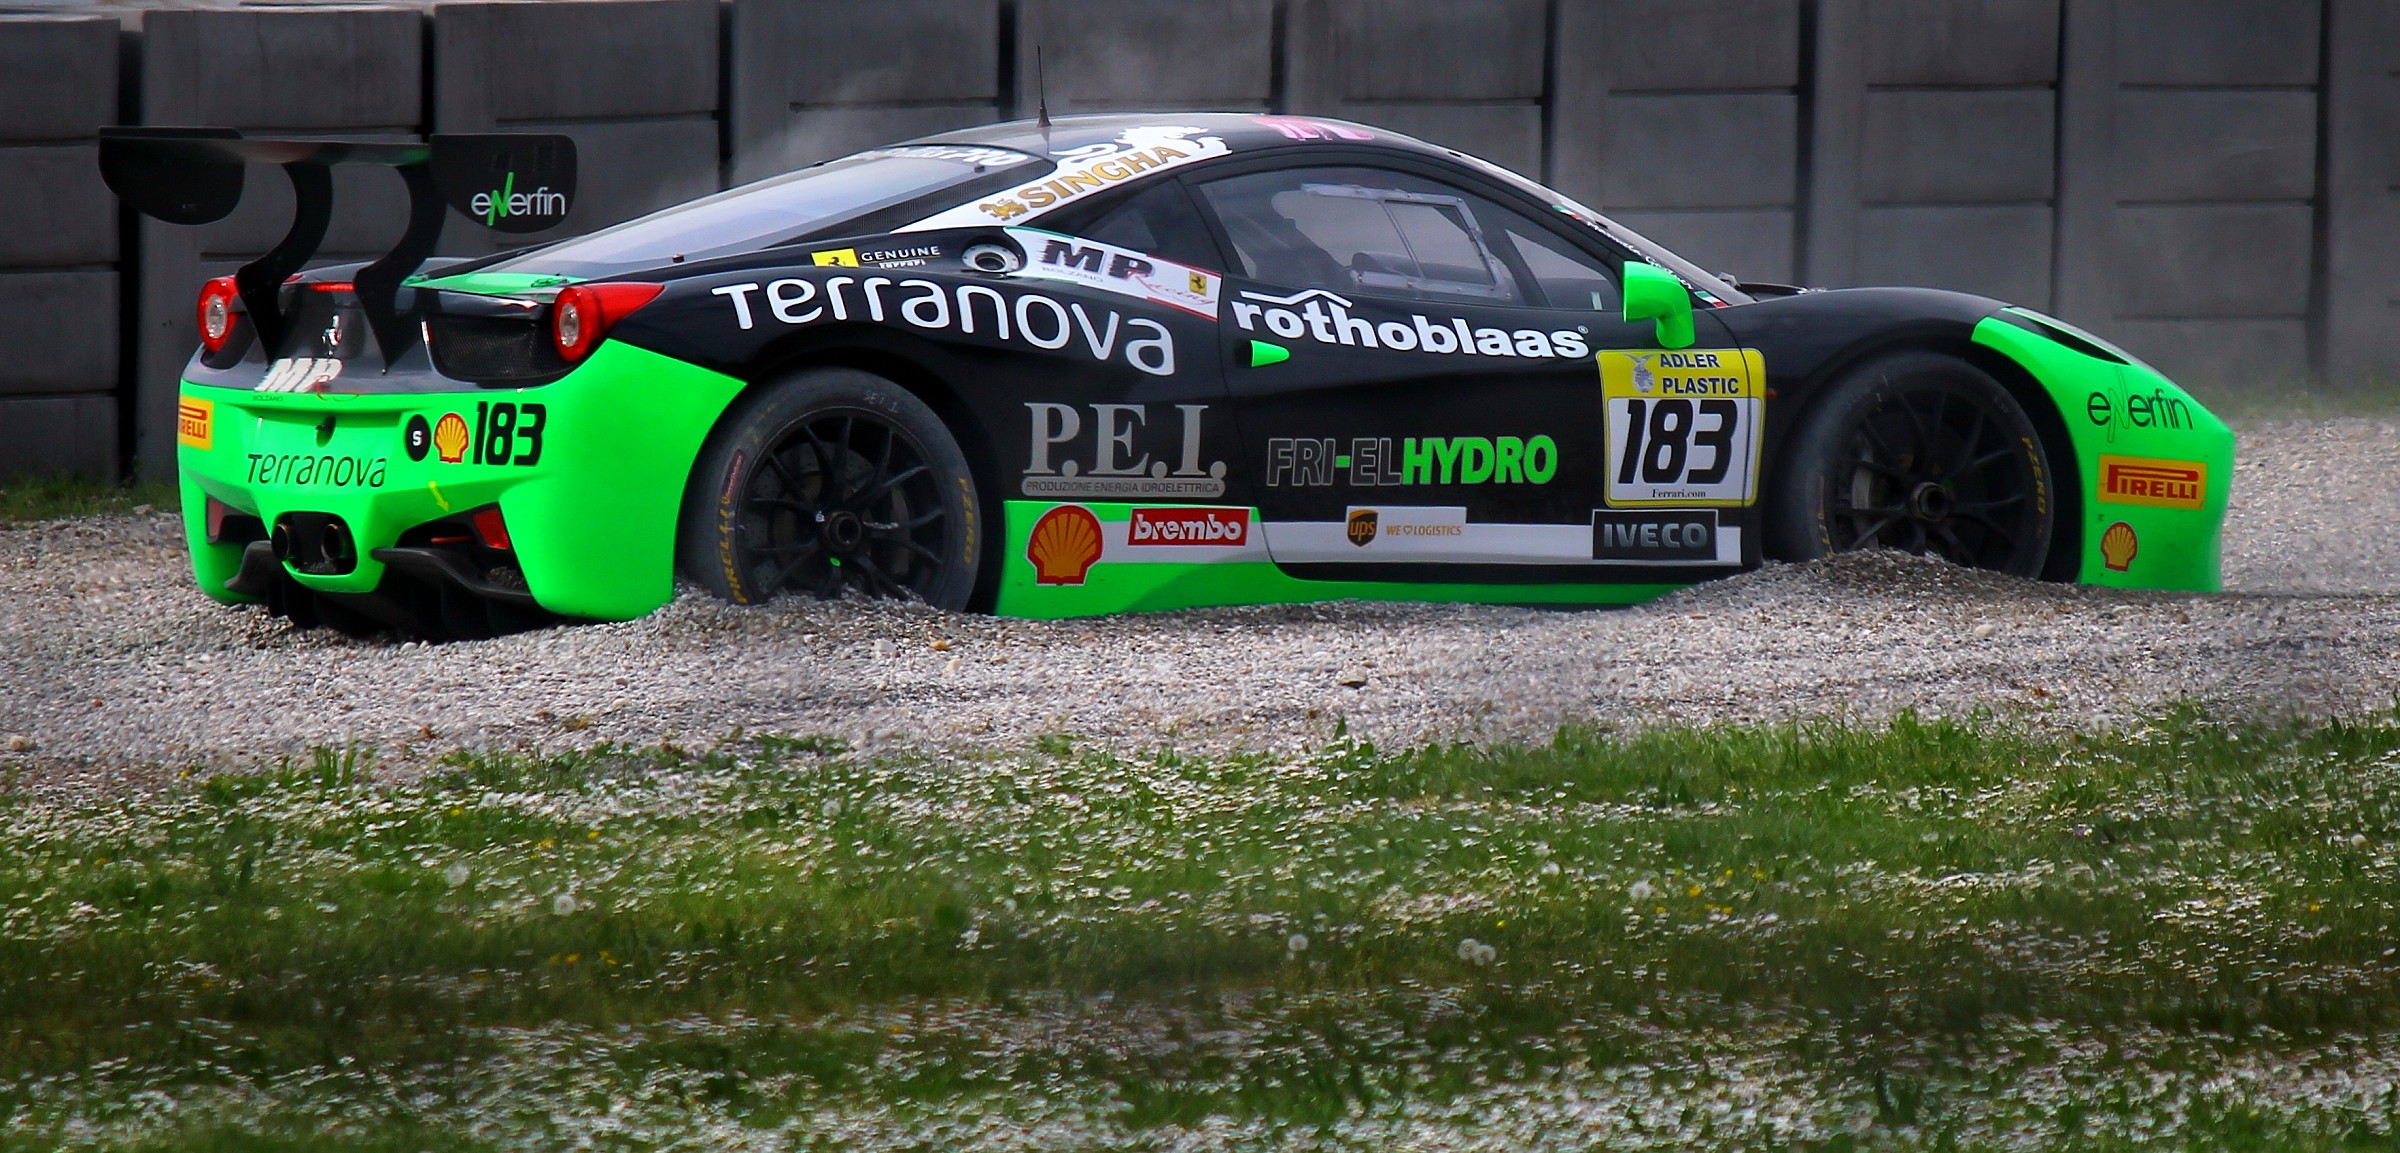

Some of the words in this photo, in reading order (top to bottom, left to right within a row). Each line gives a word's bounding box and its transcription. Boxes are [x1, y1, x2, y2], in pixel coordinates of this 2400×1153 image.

[1017, 146, 1190, 208] SINGHA
[861, 246, 940, 261] GENUINE
[1040, 239, 1155, 280] MP
[1042, 266, 1103, 283] BOLZANO
[711, 276, 1176, 377] Terranova
[1660, 353, 1720, 368] ADLER
[254, 357, 344, 392] MP
[1662, 377, 1740, 394] PLASTIC
[412, 430, 422, 446] S
[473, 401, 546, 466] 183
[1022, 402, 1228, 479] P.E.I.
[1618, 399, 1738, 484] 183
[248, 453, 388, 488] Terranova
[2107, 464, 2199, 500] PIRELLI
[1026, 480, 1091, 491] PRODUZIONE
[1095, 481, 1138, 492] ENERGIA
[1141, 482, 1220, 493] IDROELETTRICA
[1652, 488, 1706, 498] Ferrari.com
[1134, 513, 1242, 541] brembo
[1349, 521, 1376, 542] ups
[1386, 526, 1401, 536] WE
[1414, 526, 1462, 536] LOGISTICS
[1603, 522, 1708, 548] IVECO
